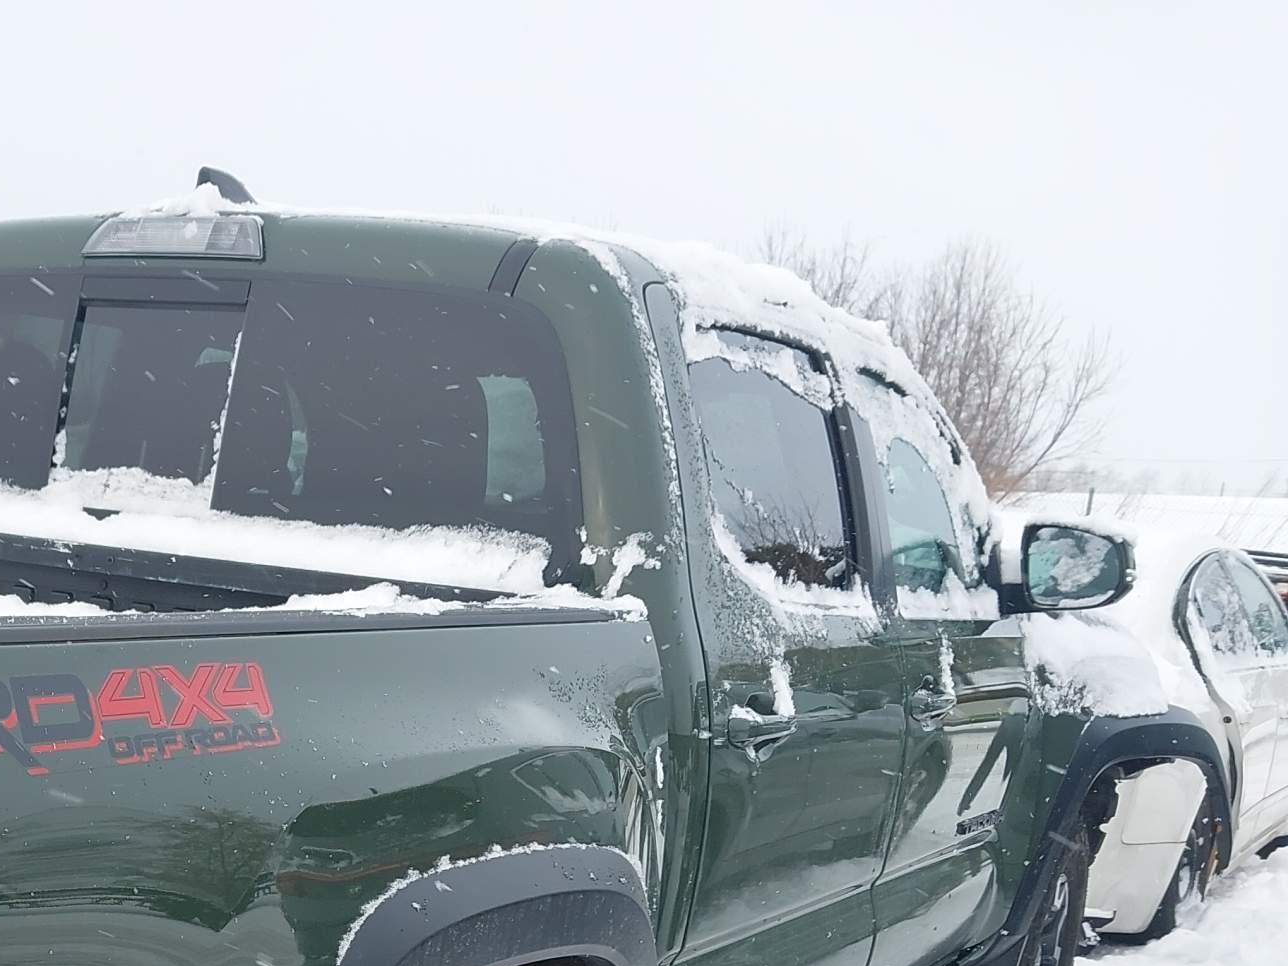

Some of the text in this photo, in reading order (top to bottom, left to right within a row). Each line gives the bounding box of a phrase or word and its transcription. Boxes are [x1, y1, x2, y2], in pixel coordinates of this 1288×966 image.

[97, 662, 275, 730] 4X4
[109, 722, 281, 765] OFF ROAD
